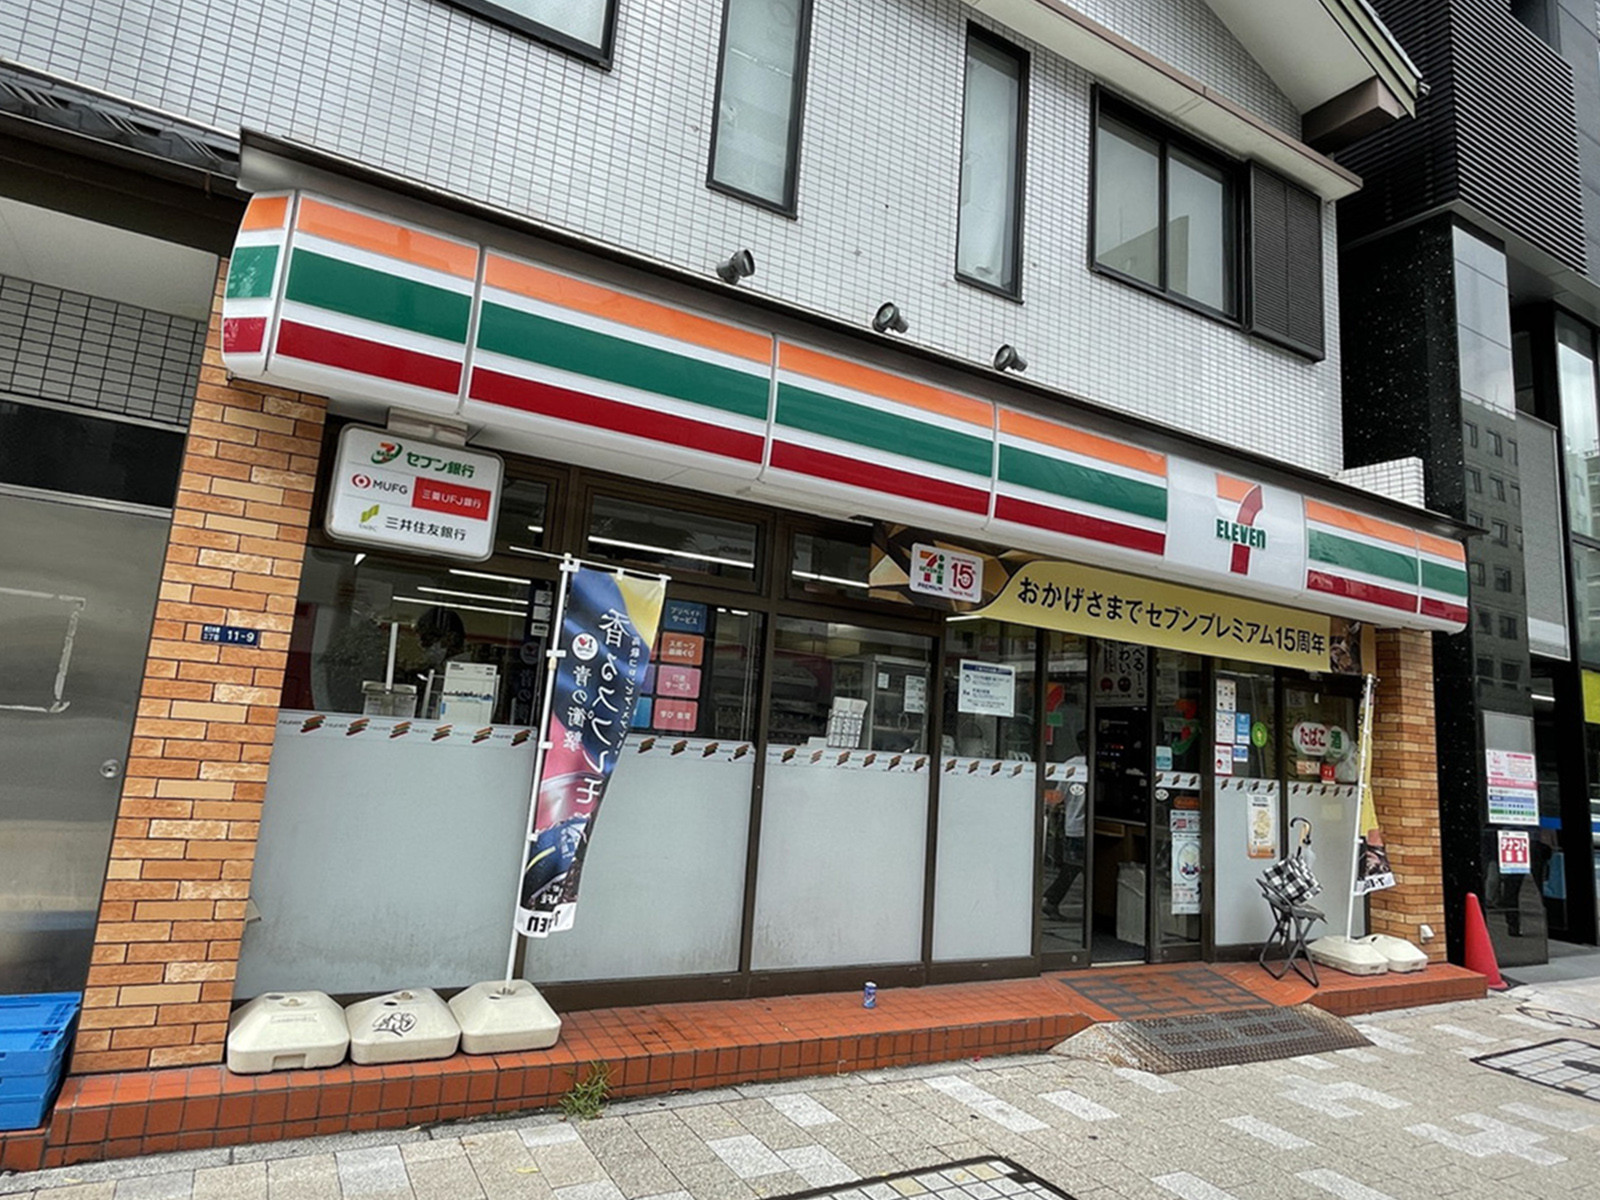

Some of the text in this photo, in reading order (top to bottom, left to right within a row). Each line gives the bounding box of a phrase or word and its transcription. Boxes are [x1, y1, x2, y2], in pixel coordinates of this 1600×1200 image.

[406, 451, 475, 479] セブン銀行
[372, 479, 408, 495] MUFG
[421, 489, 482, 509] 三菱UFJ銀行
[385, 516, 467, 541] 三井住友銀行
[1017, 577, 1326, 656] おかげさまでセブンプレミアム15周年
[226, 630, 256, 644] 11-9
[1300, 726, 1326, 747] たばこ
